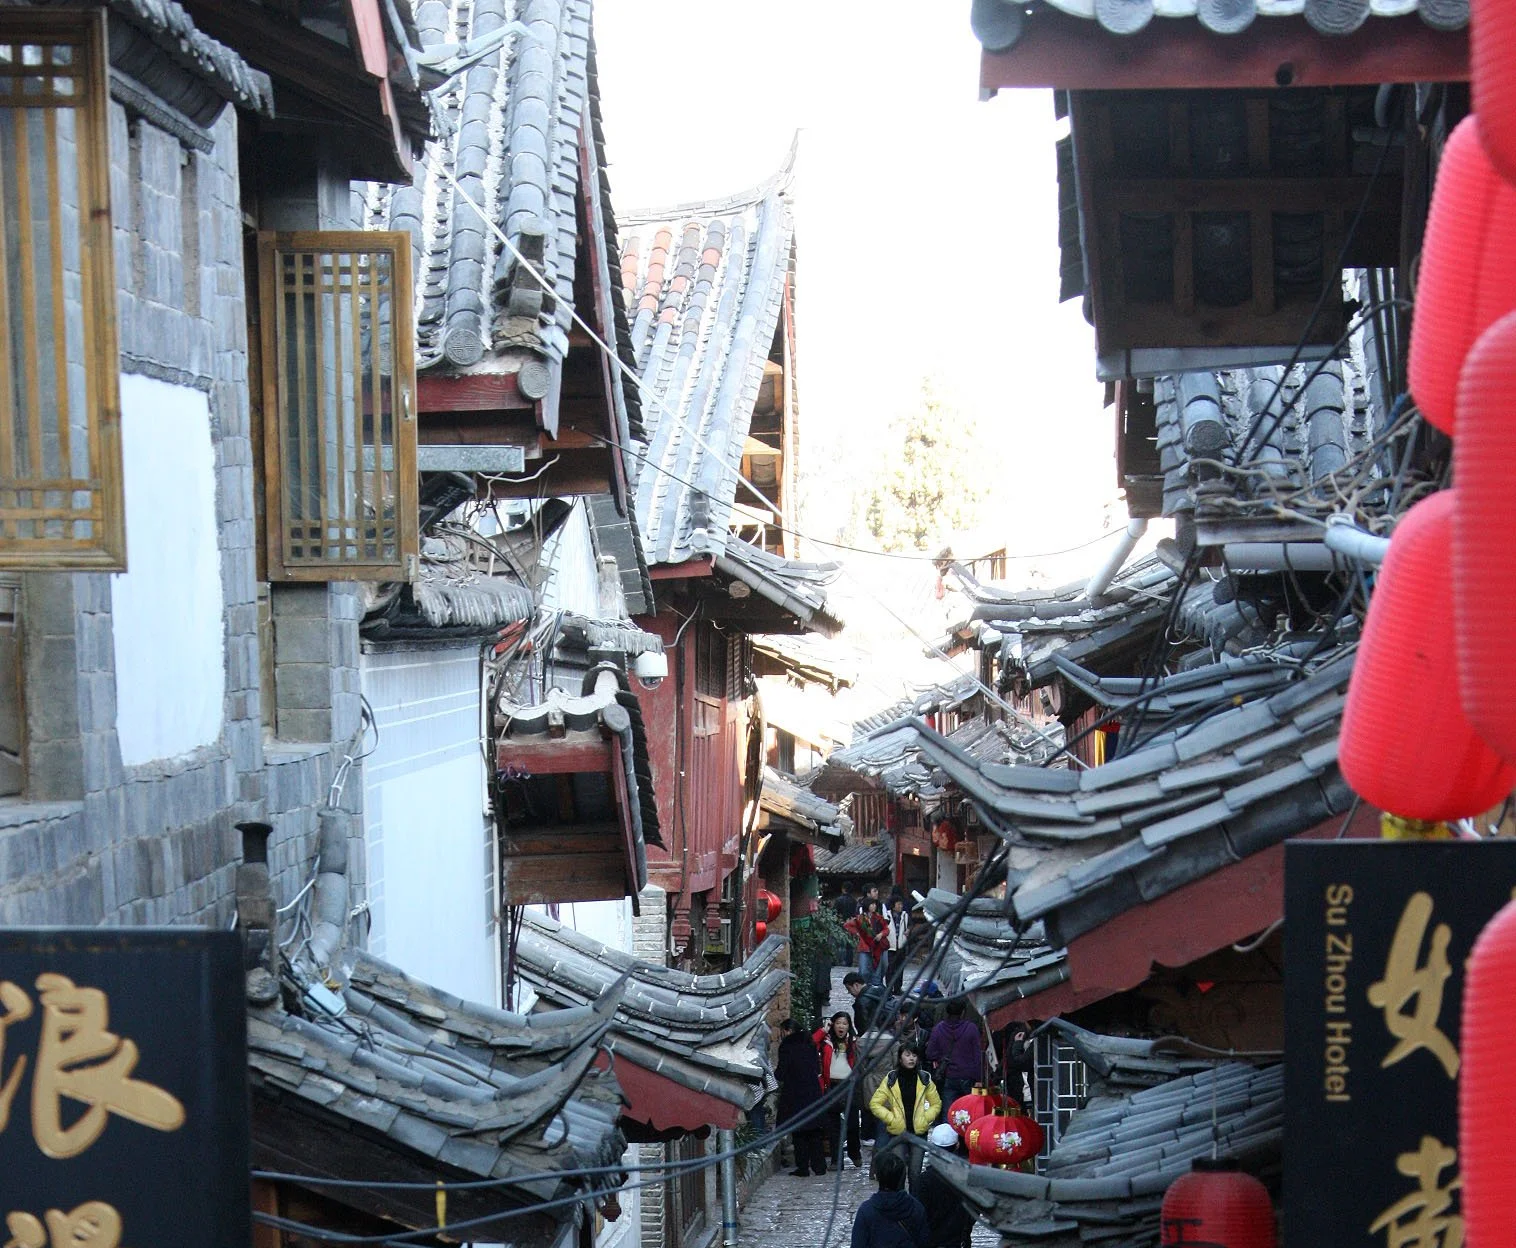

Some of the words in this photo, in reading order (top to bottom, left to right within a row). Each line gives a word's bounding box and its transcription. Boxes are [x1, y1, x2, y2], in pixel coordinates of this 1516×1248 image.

[1326, 883, 1354, 927] Su
[1325, 933, 1353, 1013] Zhou
[1324, 1022, 1352, 1102] Hotel
